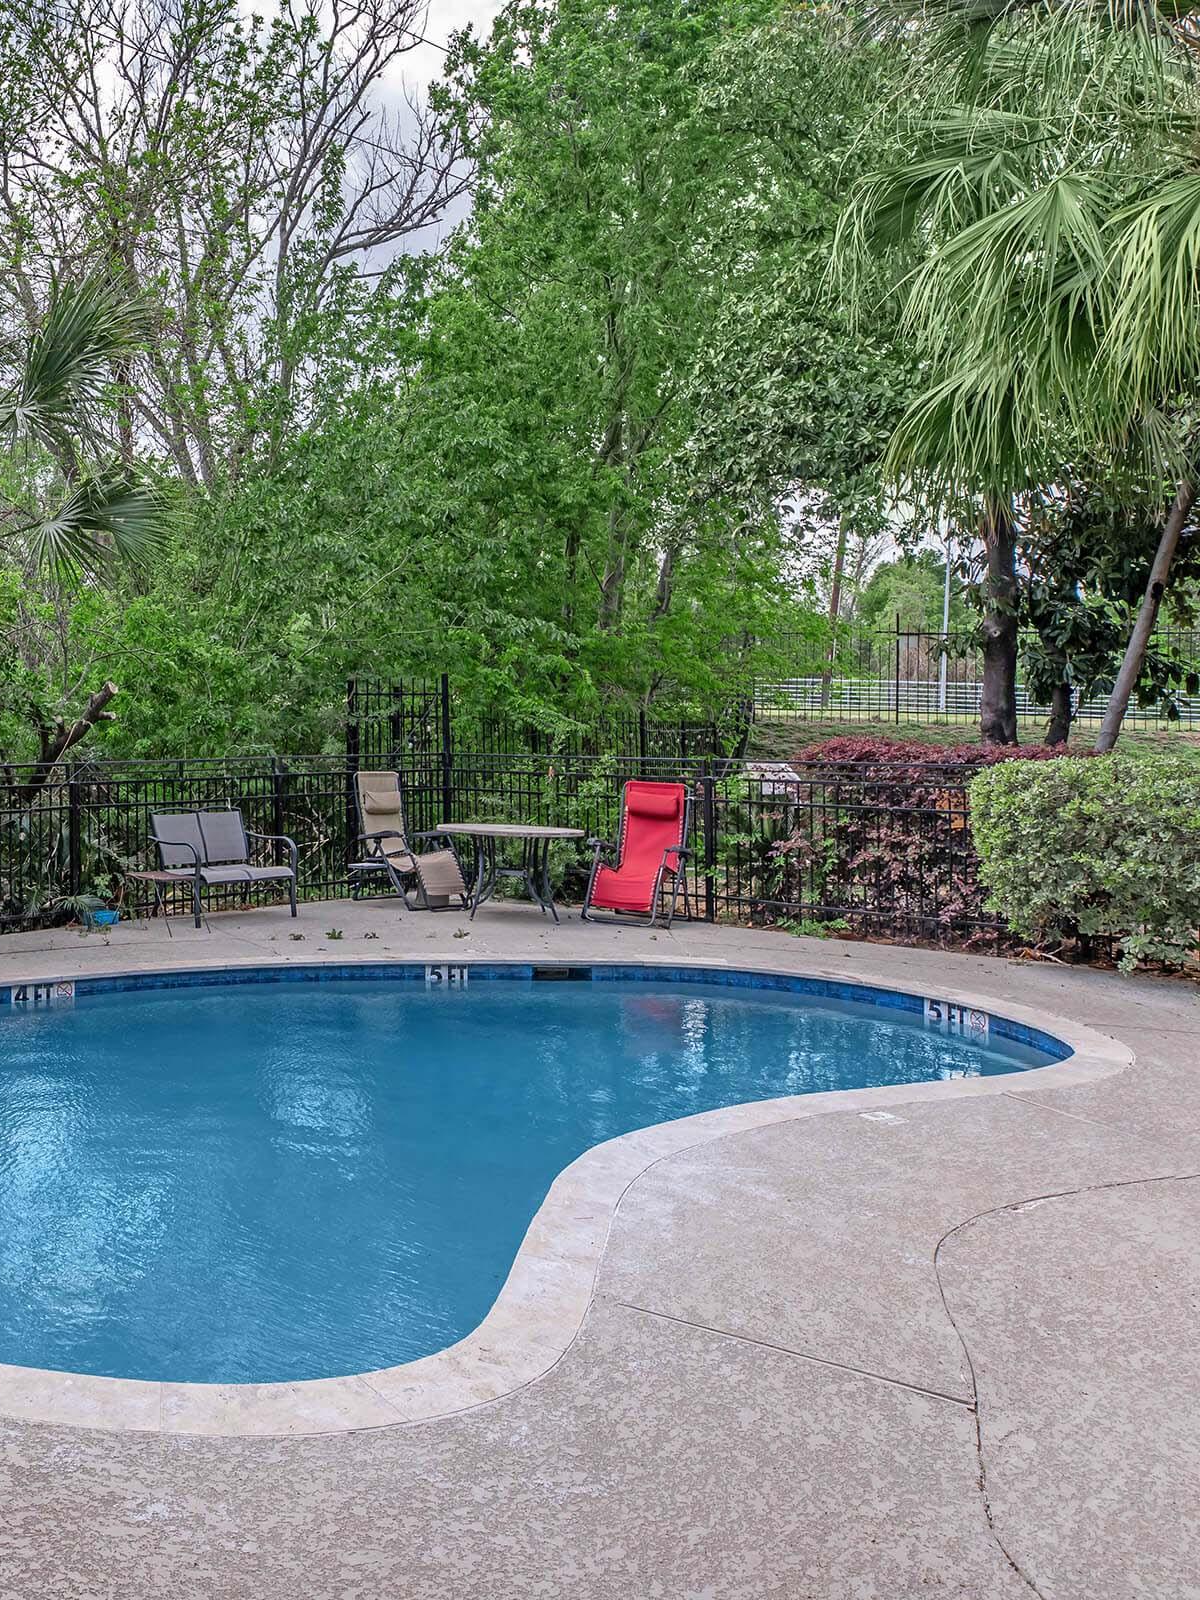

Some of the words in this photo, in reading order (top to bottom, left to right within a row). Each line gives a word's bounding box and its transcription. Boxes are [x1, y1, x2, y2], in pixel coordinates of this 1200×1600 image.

[431, 965, 443, 982] 5
[13, 984, 29, 1002] 4
[34, 983, 53, 1001] FT
[928, 999, 942, 1019] 5
[947, 1003, 968, 1025] FT
